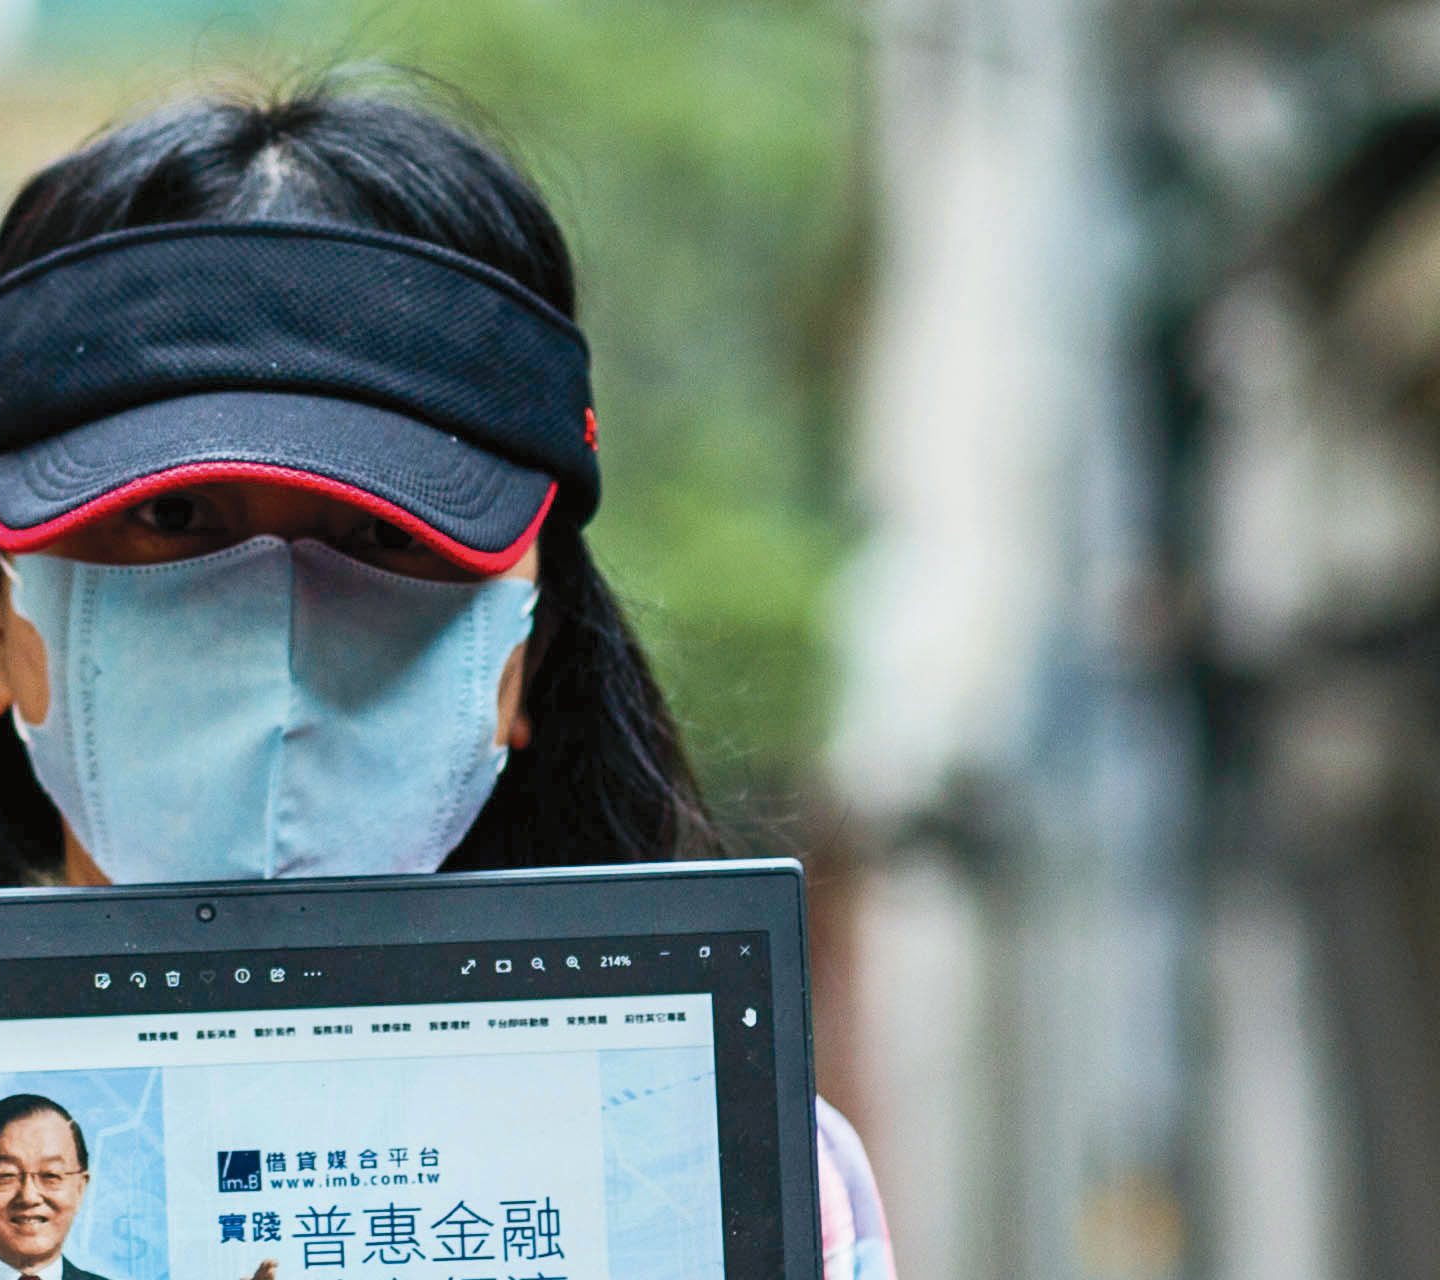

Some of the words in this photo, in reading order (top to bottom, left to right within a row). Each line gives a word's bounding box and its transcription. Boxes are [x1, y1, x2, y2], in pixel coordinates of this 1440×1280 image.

[600, 955, 631, 968] 214%
[265, 1147, 440, 1172] 借貸媒合平台
[271, 1172, 440, 1190] www.imb.com.tw
[218, 1211, 281, 1243] 實踐
[292, 1196, 565, 1269] 普惠金融
